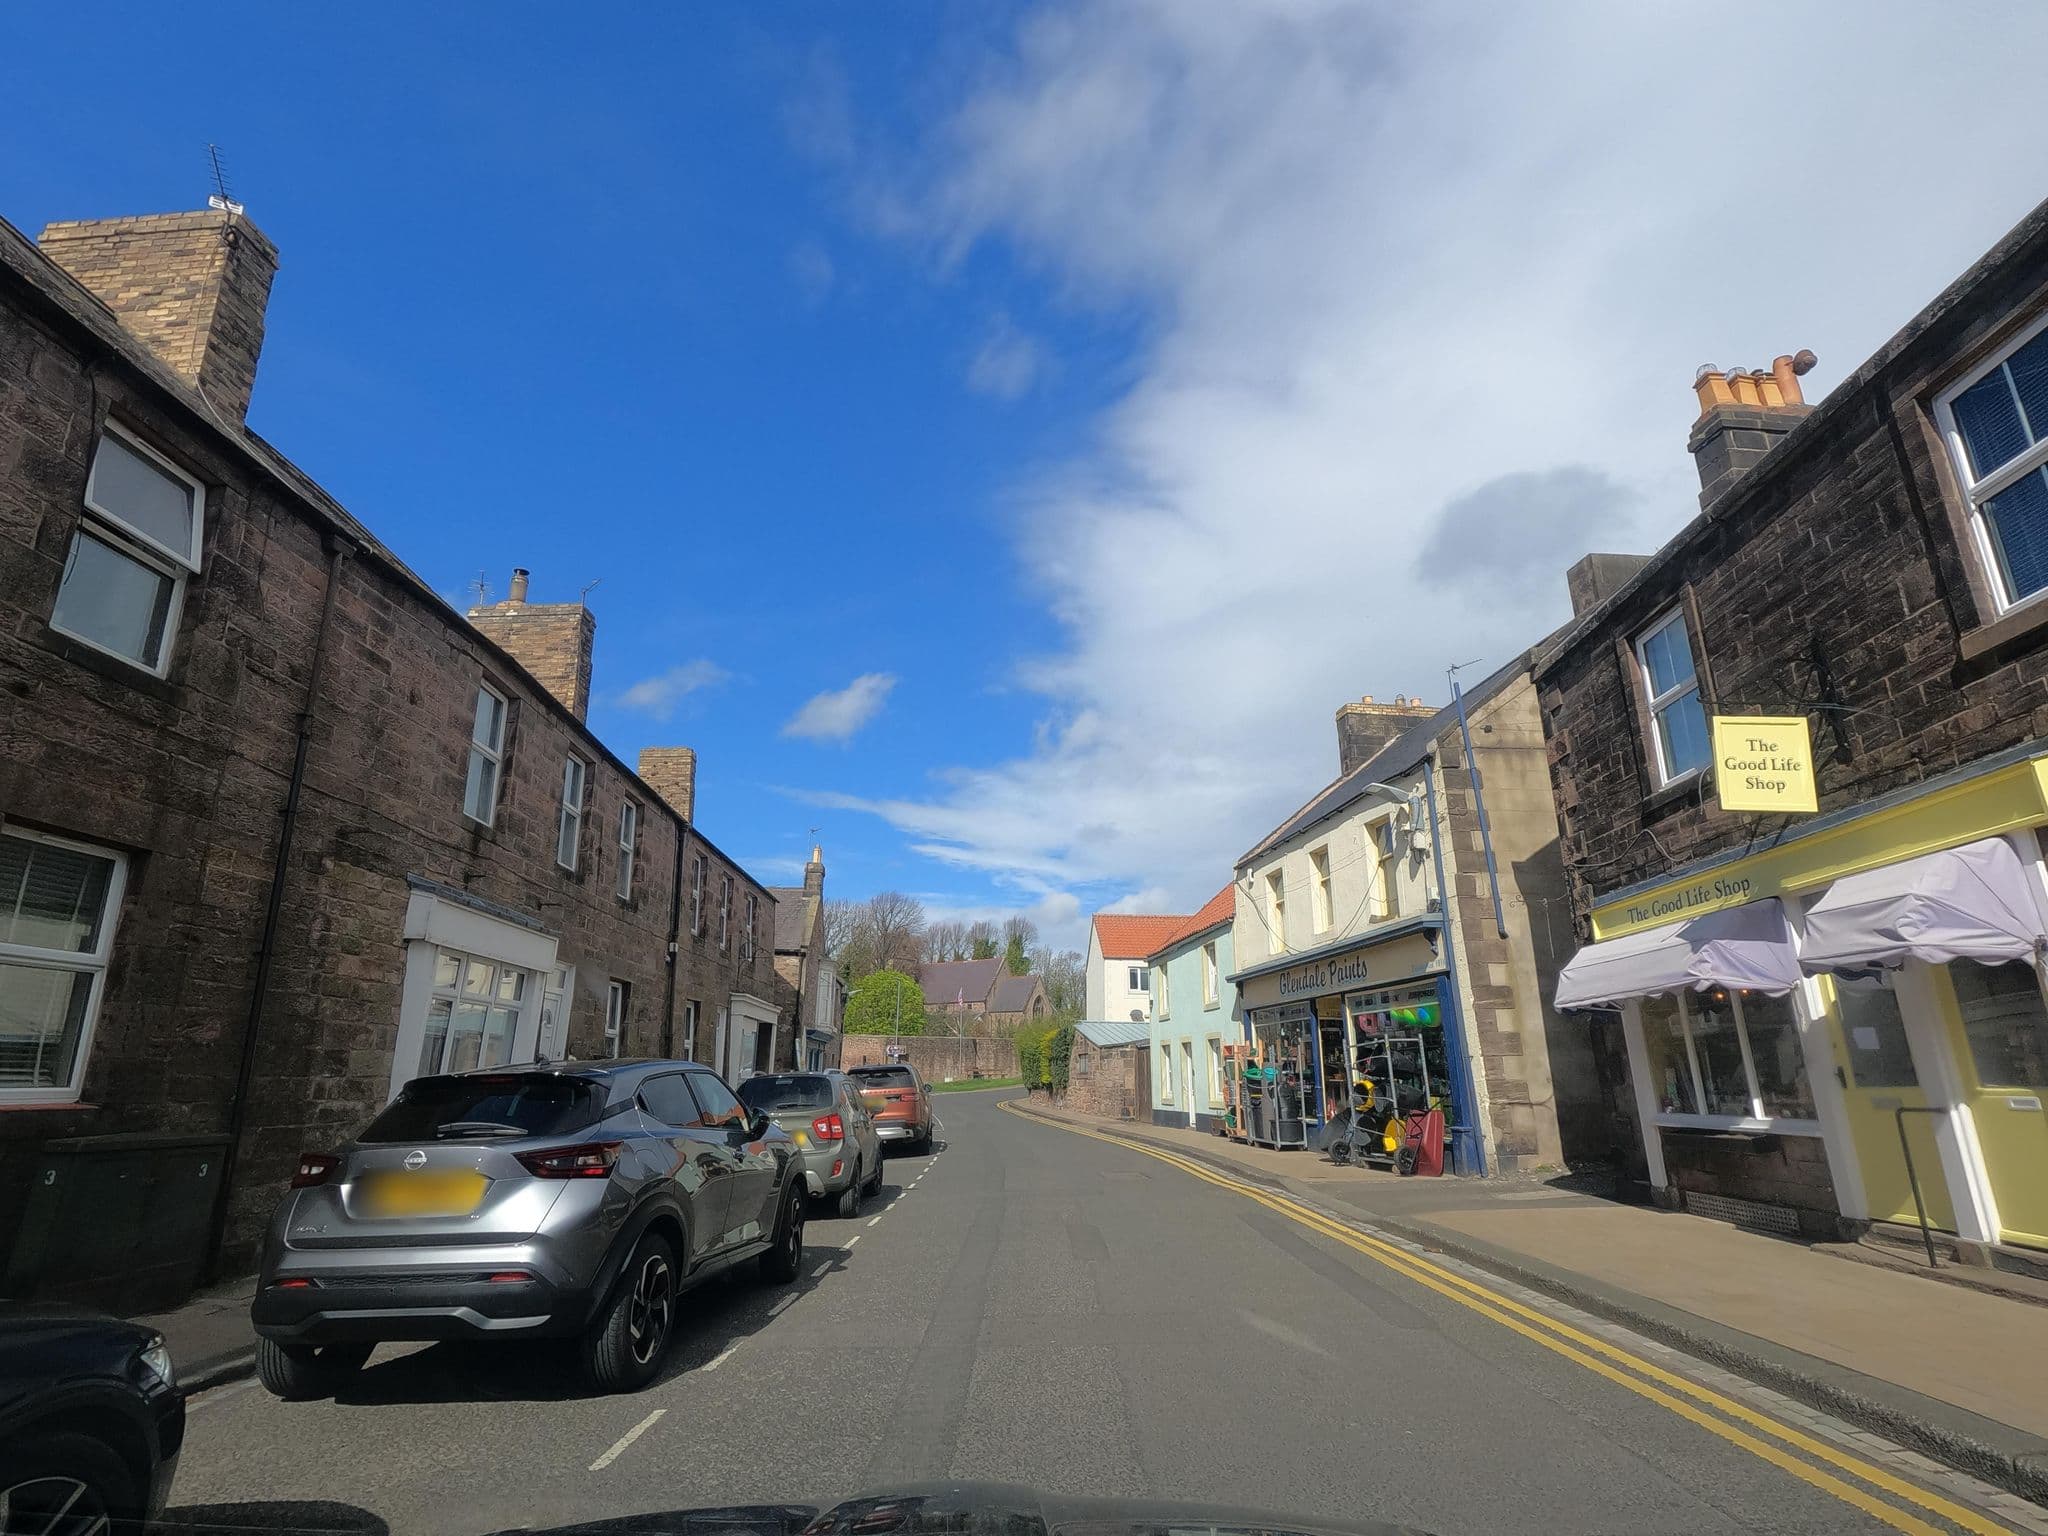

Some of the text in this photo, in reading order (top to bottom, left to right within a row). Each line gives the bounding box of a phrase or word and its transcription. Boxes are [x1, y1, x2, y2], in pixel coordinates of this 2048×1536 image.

[1746, 739, 1778, 752] The
[1724, 757, 1801, 771] Good Life
[1745, 777, 1786, 794] Shop
[1627, 878, 1751, 924] The Good Life Shop
[1280, 956, 1367, 994] Glendale Paints
[45, 1170, 56, 1185] 3
[199, 1163, 208, 1177] 3
